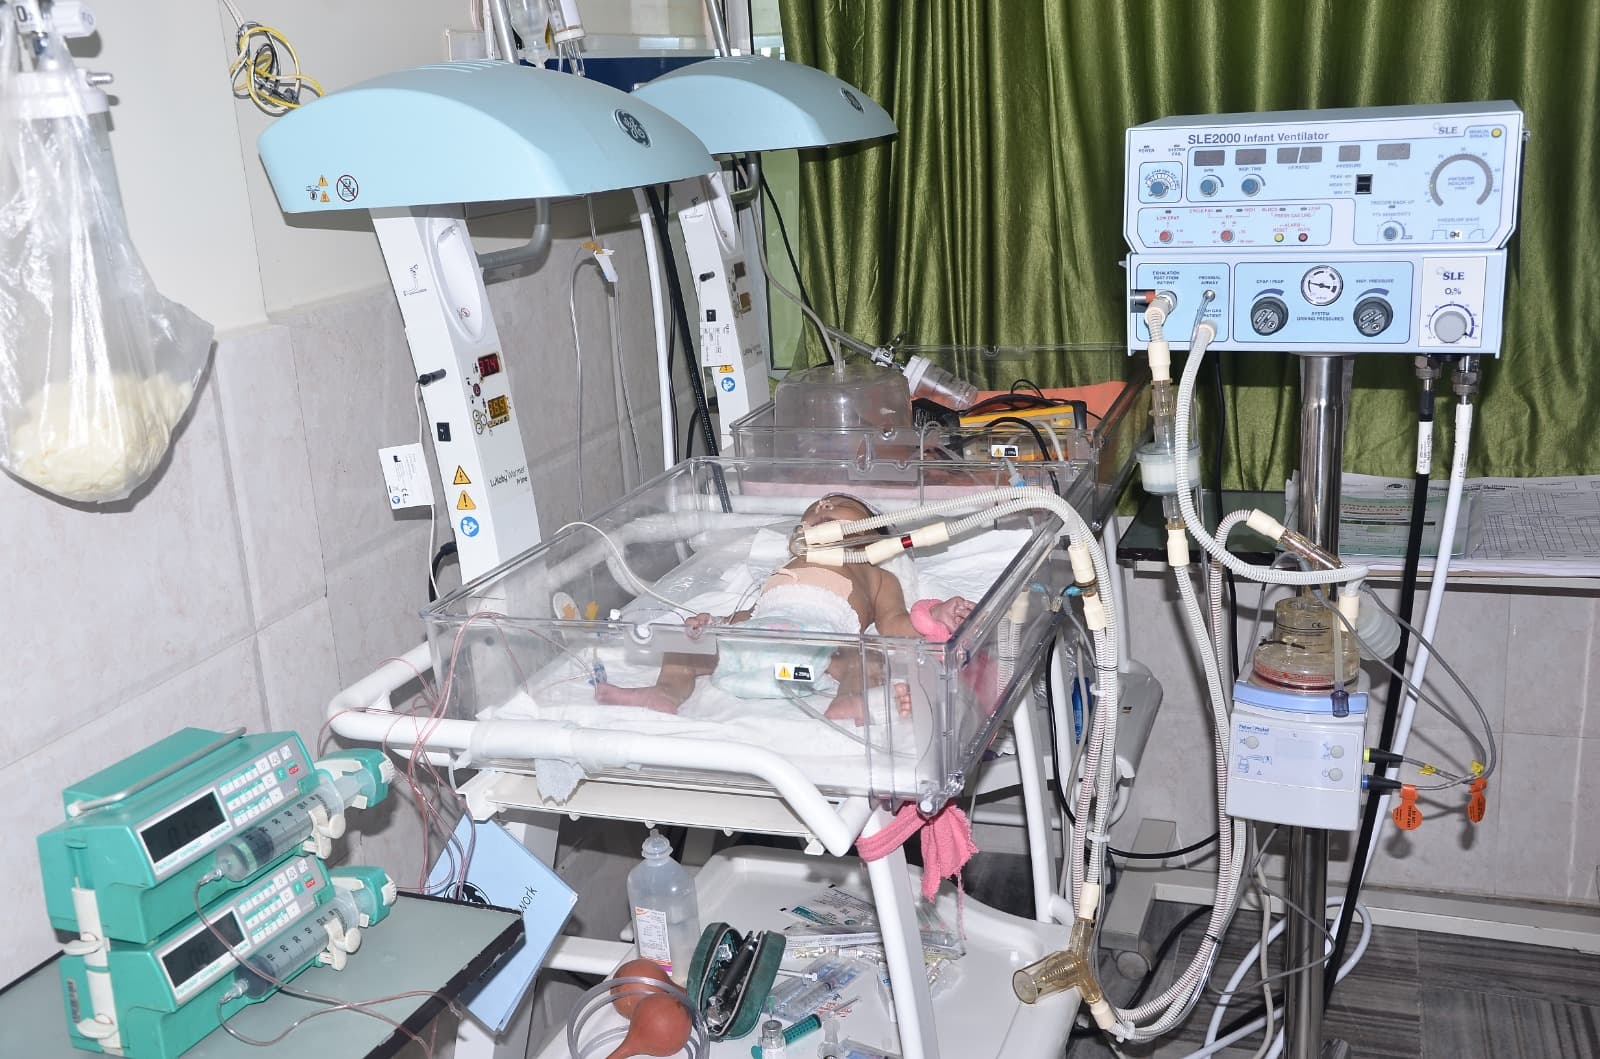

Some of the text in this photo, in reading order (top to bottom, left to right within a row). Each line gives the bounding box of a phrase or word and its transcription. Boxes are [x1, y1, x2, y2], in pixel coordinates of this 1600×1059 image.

[1438, 126, 1458, 135] SLE
[1188, 131, 1329, 145] SLE2000 Infant Ventilator
[1442, 271, 1465, 280] SLE
